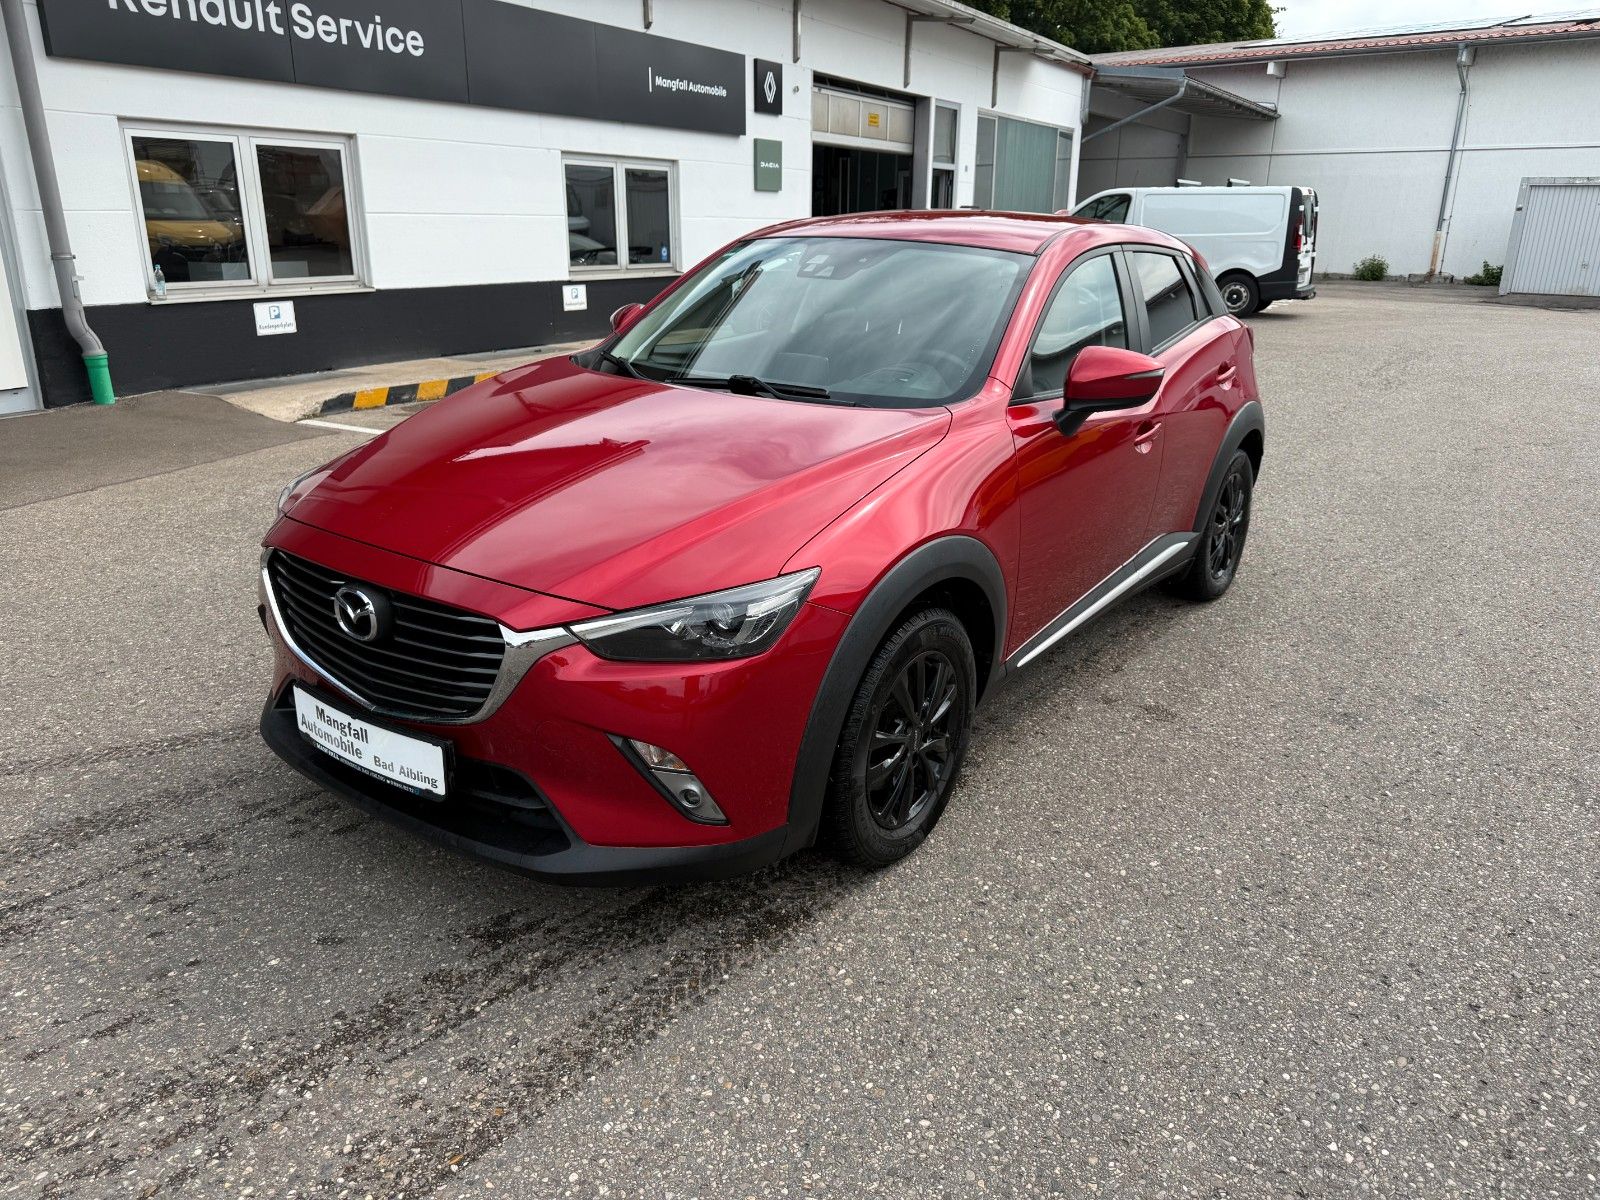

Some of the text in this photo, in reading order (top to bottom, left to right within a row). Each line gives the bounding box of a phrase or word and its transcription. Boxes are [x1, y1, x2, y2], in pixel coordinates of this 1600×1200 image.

[108, 0, 425, 57] enault Service
[655, 75, 727, 97] Mangfall Automobile
[270, 306, 280, 318] P
[301, 713, 363, 760] Automobile
[315, 705, 369, 744] Mangfall
[373, 755, 394, 773] Bad
[399, 765, 438, 789] Aibling
